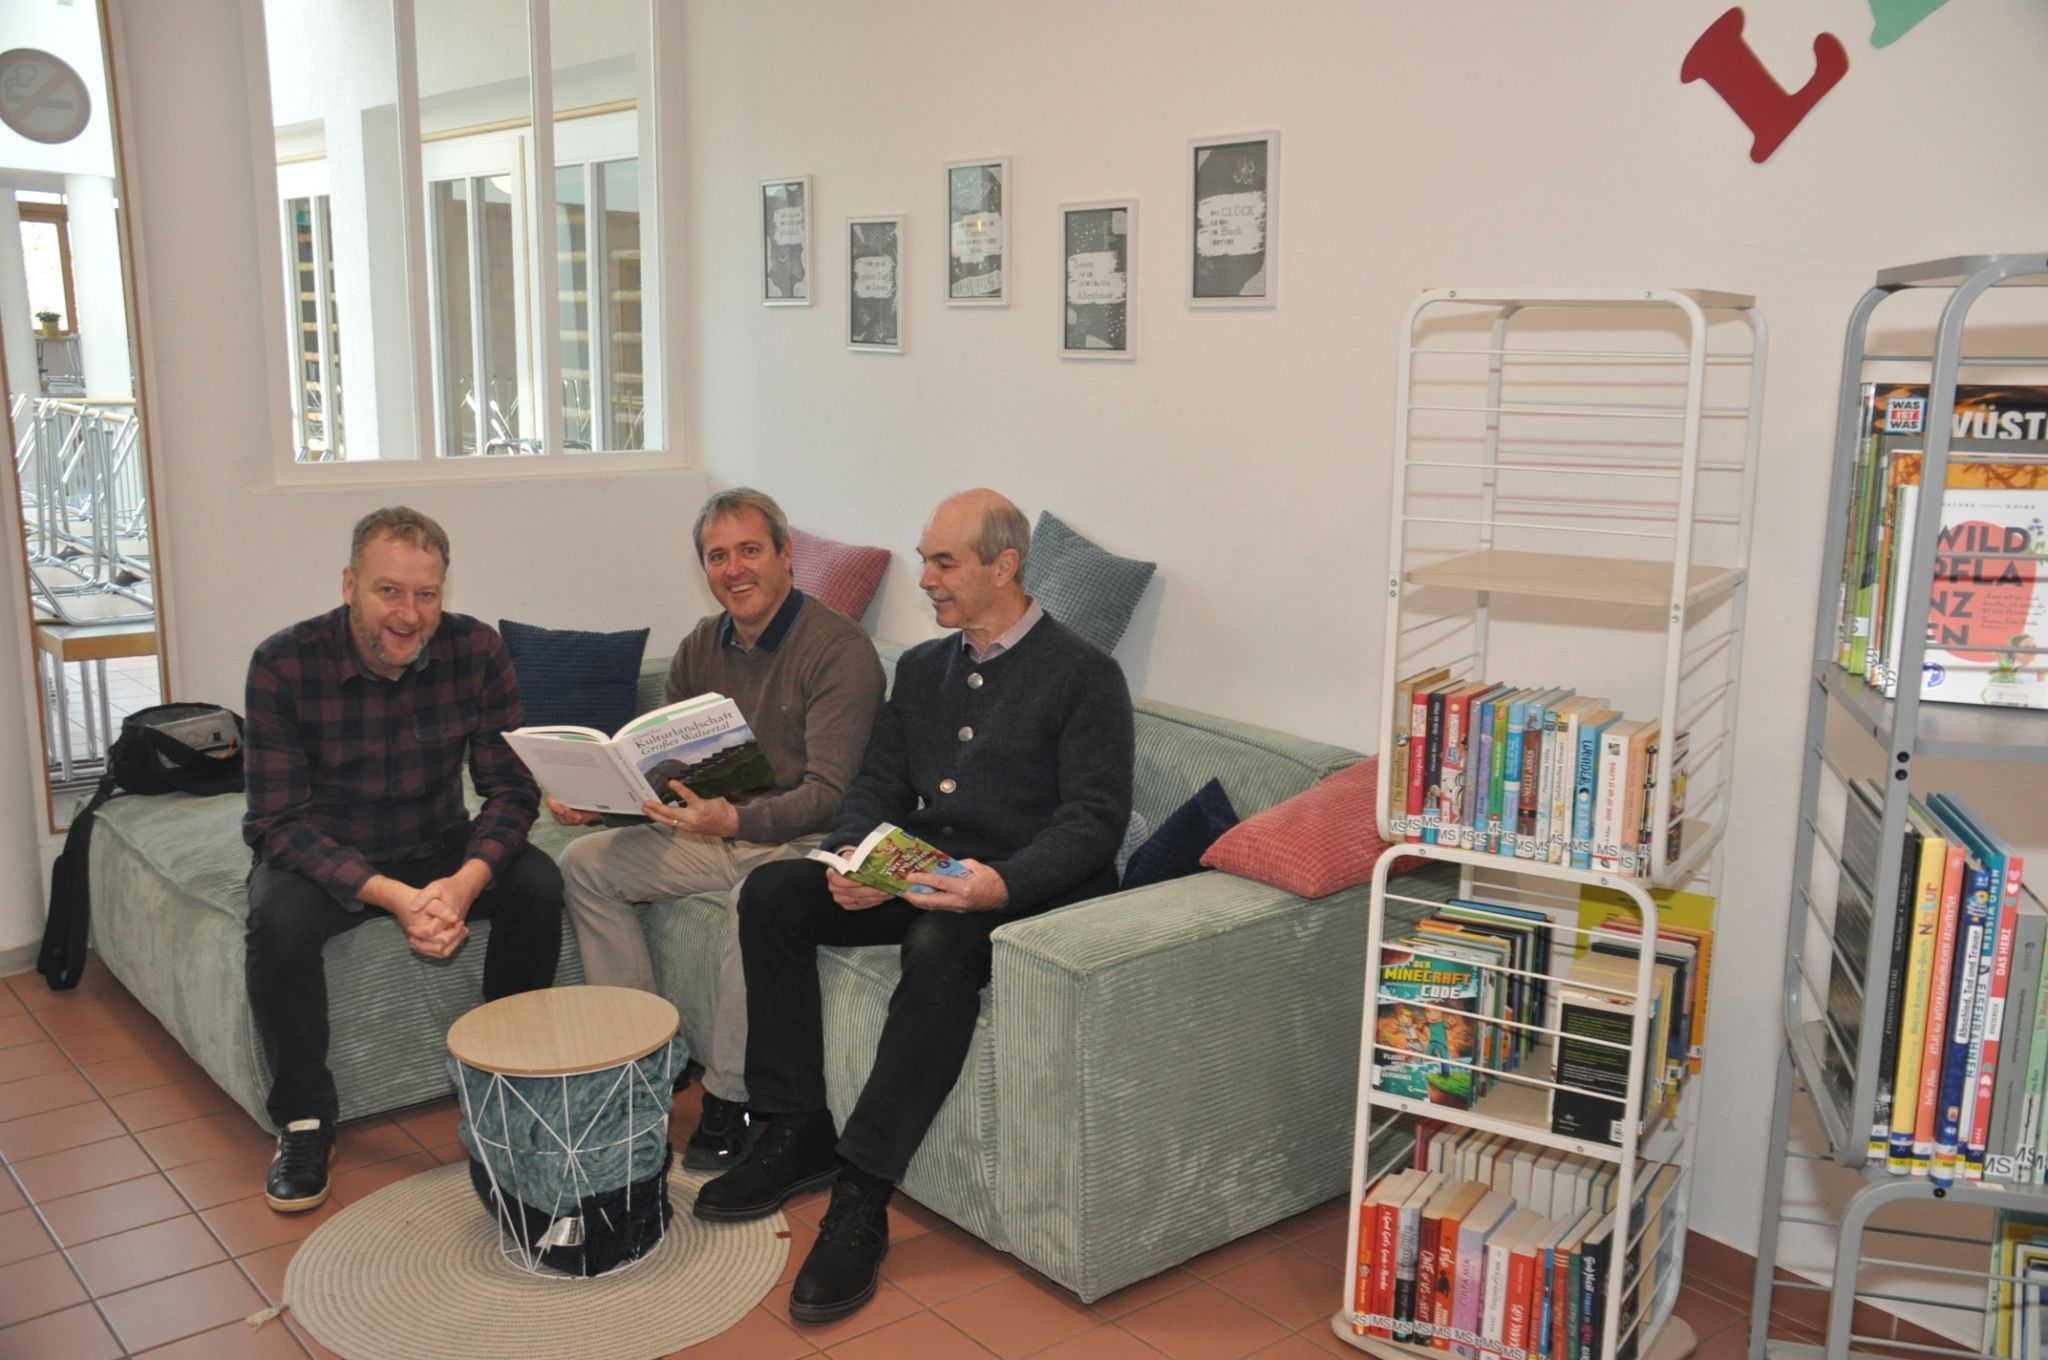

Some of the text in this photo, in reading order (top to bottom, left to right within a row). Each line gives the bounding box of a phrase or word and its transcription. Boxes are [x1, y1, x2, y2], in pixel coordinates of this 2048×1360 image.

[1892, 401, 1920, 409] WAS
[1897, 411, 1915, 419] IST
[1891, 420, 1918, 429] WAS
[635, 711, 733, 749] Kulturlandschaft
[641, 739, 680, 755] Großes
[681, 721, 730, 742] Walsertal
[1579, 740, 1593, 786] WONDER
[1390, 821, 1407, 833] MS
[1422, 816, 1440, 827] MS
[1440, 829, 1456, 840] MS
[1516, 840, 1533, 852] MS
[1572, 841, 1591, 852] MS
[1597, 843, 1618, 856] MS
[1919, 883, 1938, 935] Natur
[1995, 928, 2011, 976] DAS HERZ
[1413, 960, 1431, 968] DER
[1384, 968, 1472, 987] MINECRAFT
[1930, 1034, 1940, 1055] ATLAS
[1944, 895, 1956, 941] ARCHITEKTUR
[1958, 930, 1980, 1039] Abschied, Tod und Trauer
[1422, 985, 1460, 999] CODE
[1911, 1010, 1921, 1034] Mein
[1966, 984, 1986, 1078] EISENBAHNEN
[1924, 1088, 1934, 1105] Peter
[1985, 1156, 2011, 1174] MS
[1421, 1250, 1435, 1274] ONE
[1583, 1256, 1596, 1273] Good
[1460, 1278, 1468, 1306] CULPA
[1372, 1316, 1391, 1328] MS
[1393, 1322, 1412, 1333] MS
[1414, 1320, 1432, 1333] MS
[1432, 1326, 1450, 1337] MS
[1455, 1330, 1474, 1343] MS
[1482, 1337, 1500, 1350] MS
[1503, 1347, 1523, 1360] MS
